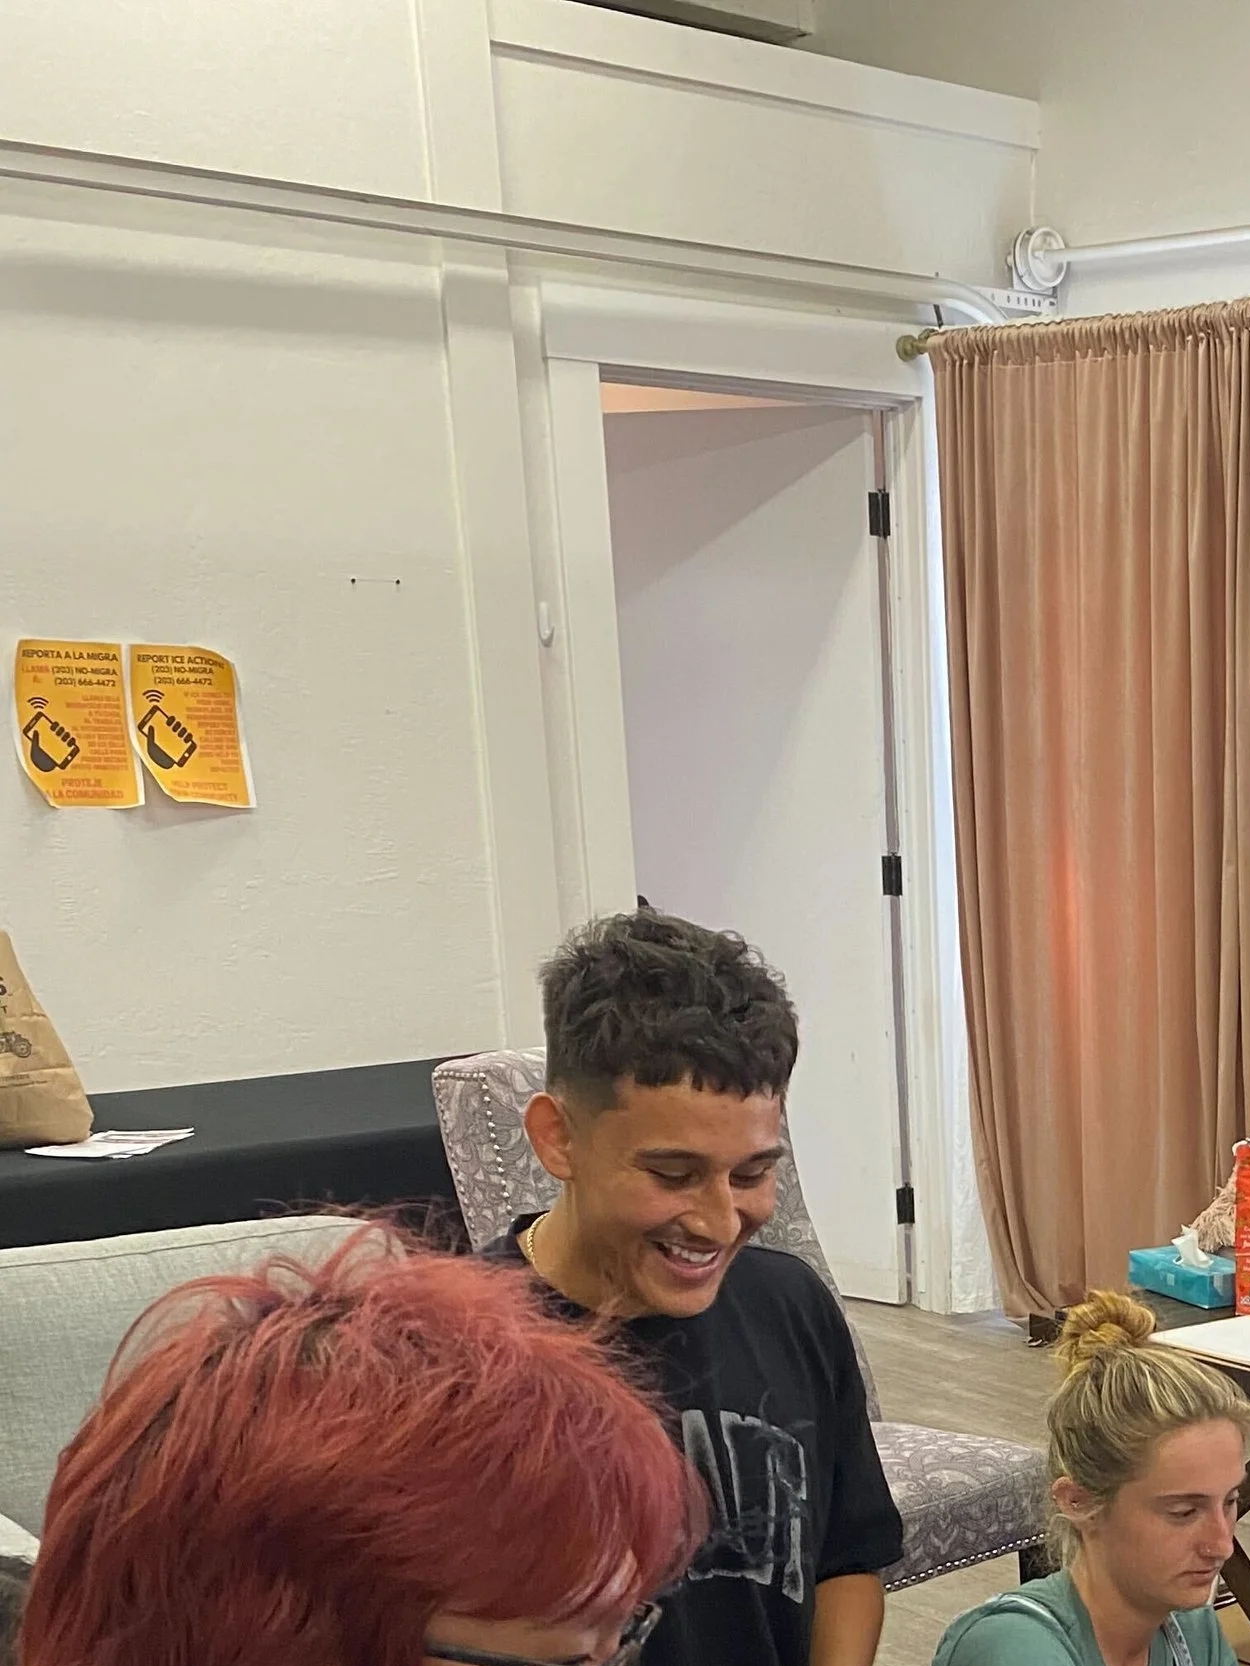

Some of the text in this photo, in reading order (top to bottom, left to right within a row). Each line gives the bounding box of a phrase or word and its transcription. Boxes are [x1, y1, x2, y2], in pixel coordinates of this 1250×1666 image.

[22, 649, 119, 662] REPORTA A LA MIGRA
[137, 654, 169, 664] REPORT
[171, 655, 185, 664] ICE
[75, 666, 118, 676] NO-MIGRA
[174, 666, 215, 675] NO-MIGRA
